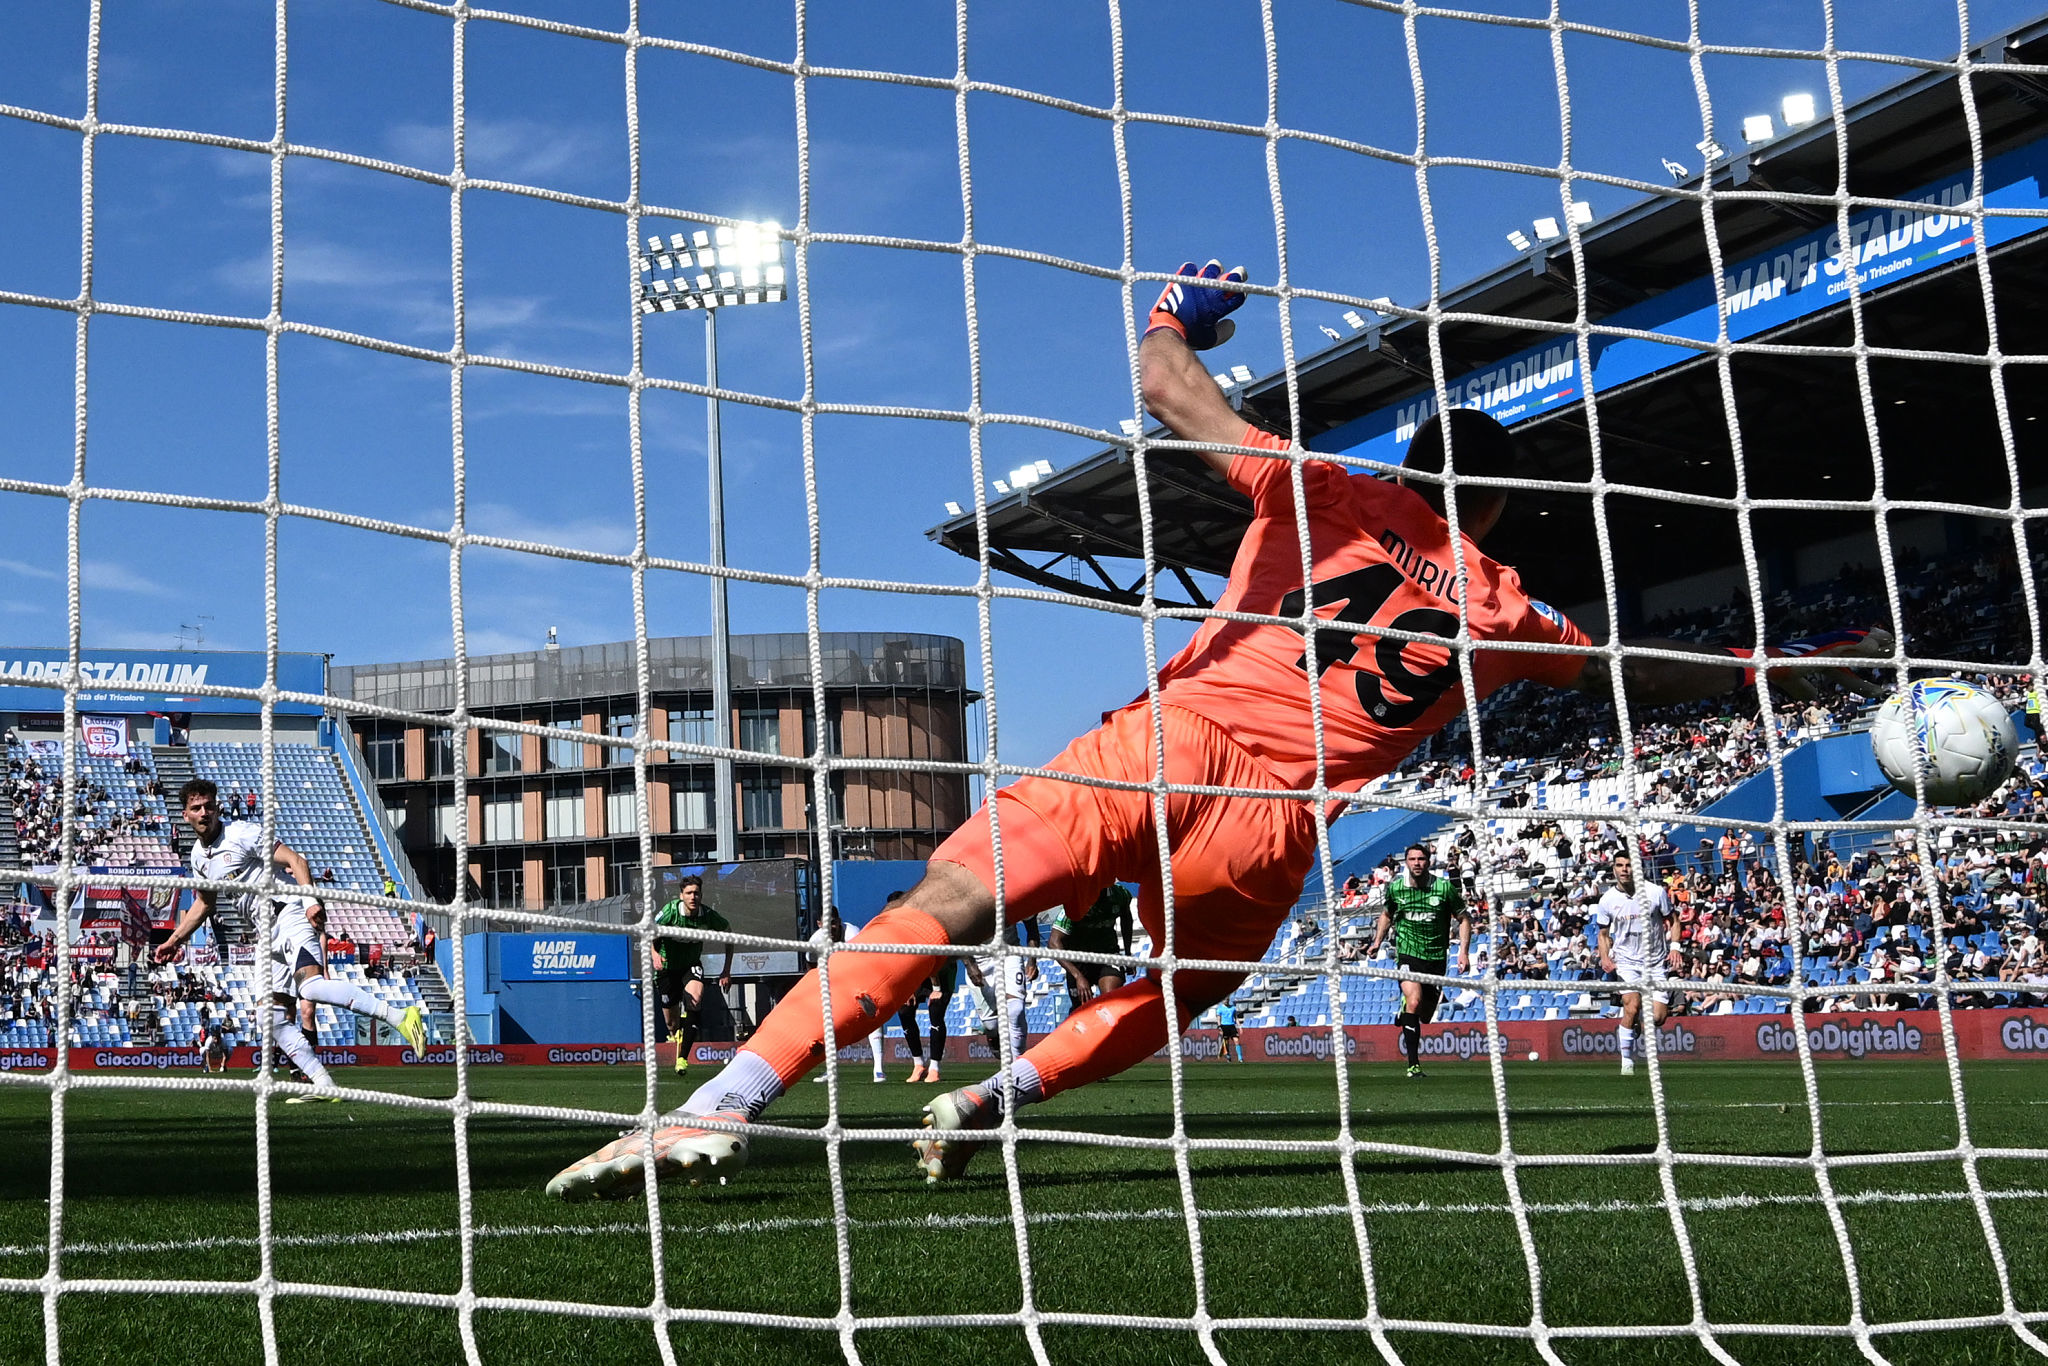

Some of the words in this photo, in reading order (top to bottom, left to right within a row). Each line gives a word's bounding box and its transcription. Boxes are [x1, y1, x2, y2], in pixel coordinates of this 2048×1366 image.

[1724, 240, 1818, 316] MAPEI
[1824, 174, 1984, 277] STADIUM
[1869, 257, 1913, 280] Tricolore
[1464, 340, 1575, 411] STADIUM
[76, 661, 209, 691] STADIUM
[532, 941, 577, 955] MAPEI
[532, 955, 597, 969] STADIUM
[1757, 1020, 1922, 1057] GiooDigitale
[95, 1052, 203, 1069] GiocoDigitale
